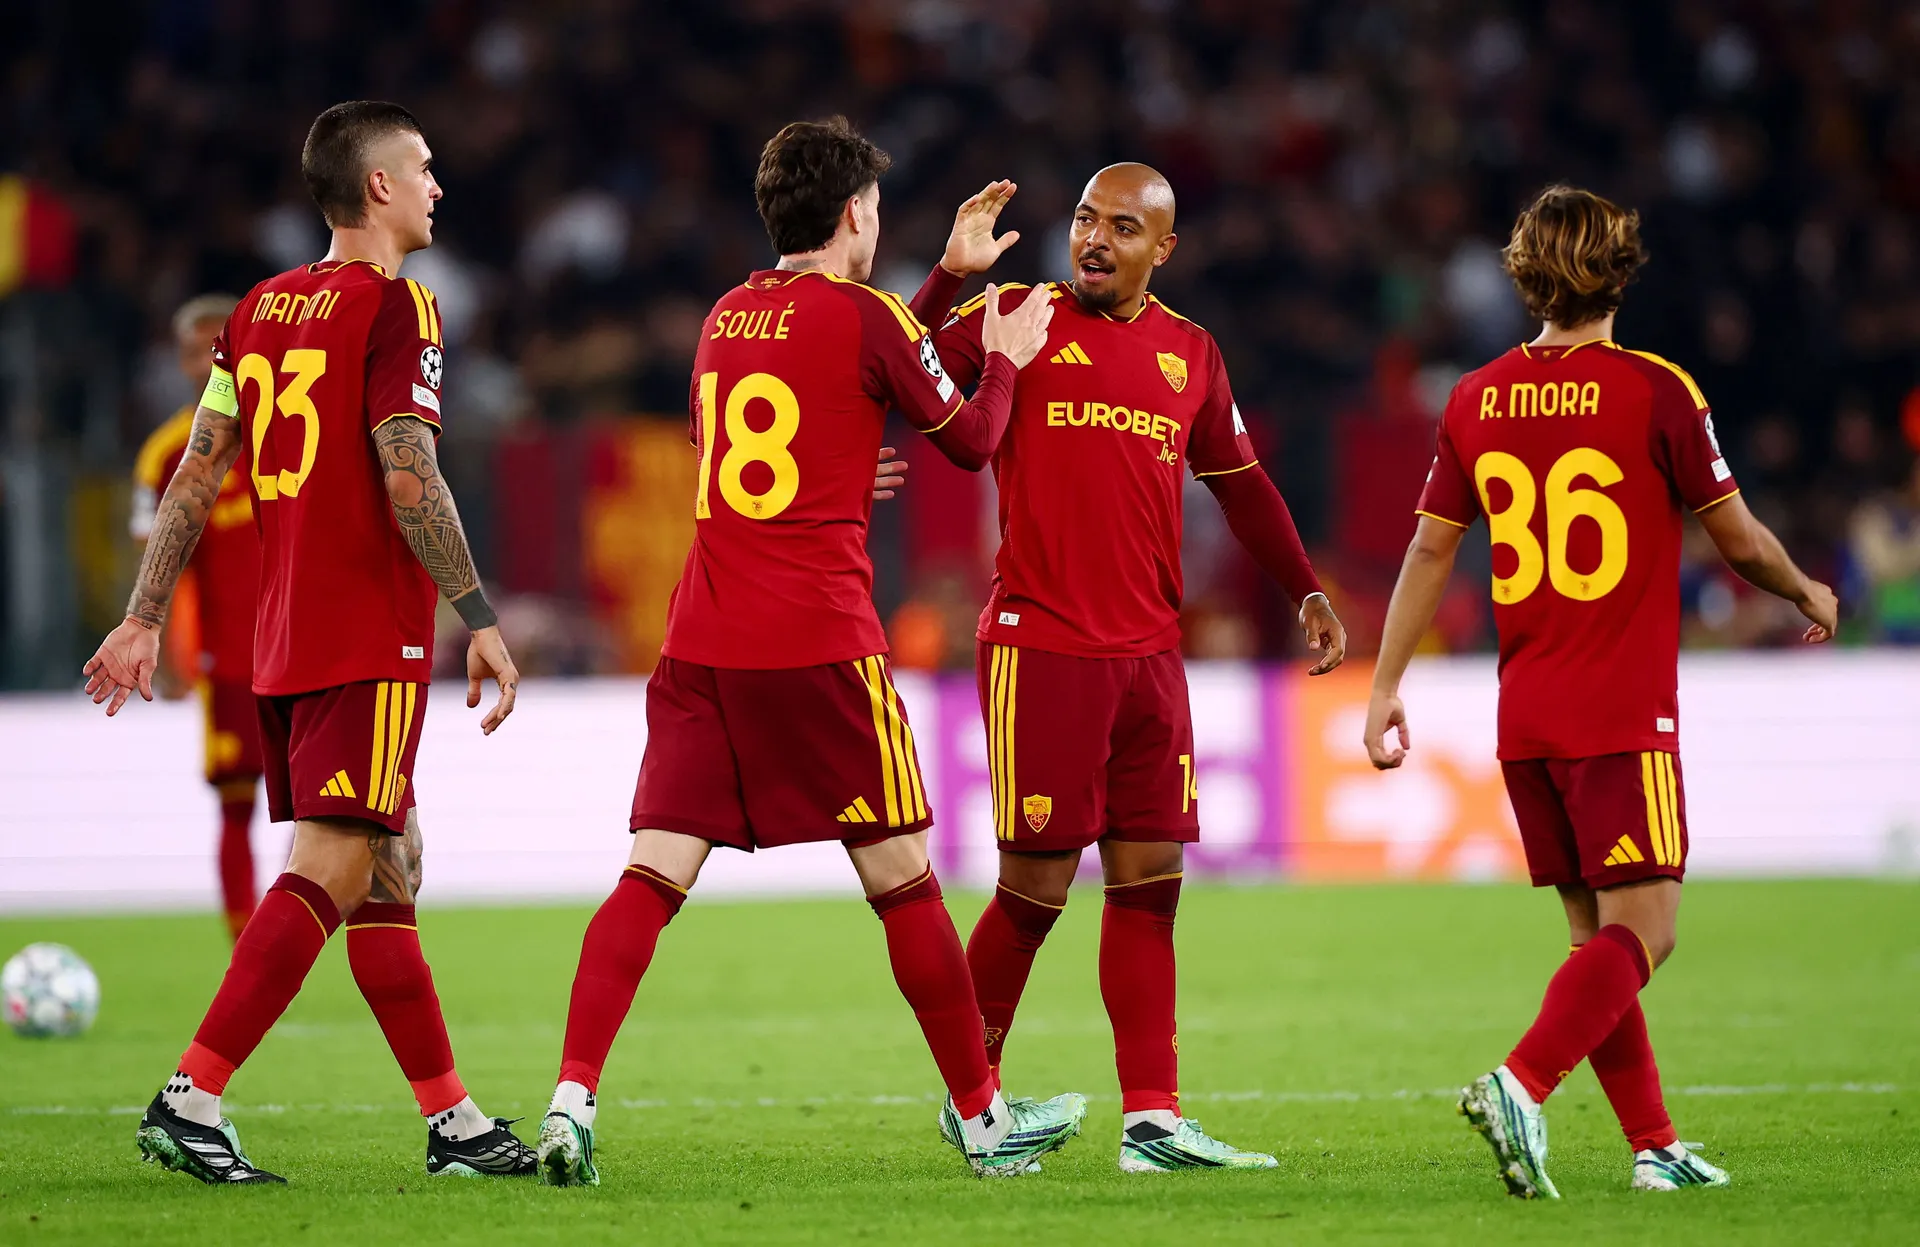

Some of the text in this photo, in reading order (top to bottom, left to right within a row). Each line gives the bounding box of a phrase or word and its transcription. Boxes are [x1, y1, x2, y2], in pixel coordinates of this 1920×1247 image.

[710, 302, 795, 340] SOULÉ
[236, 349, 327, 501] 23
[696, 371, 800, 520] 18
[1047, 401, 1181, 446] EUROBET
[1480, 381, 1600, 420] R. MORA
[1474, 447, 1628, 605] 86
